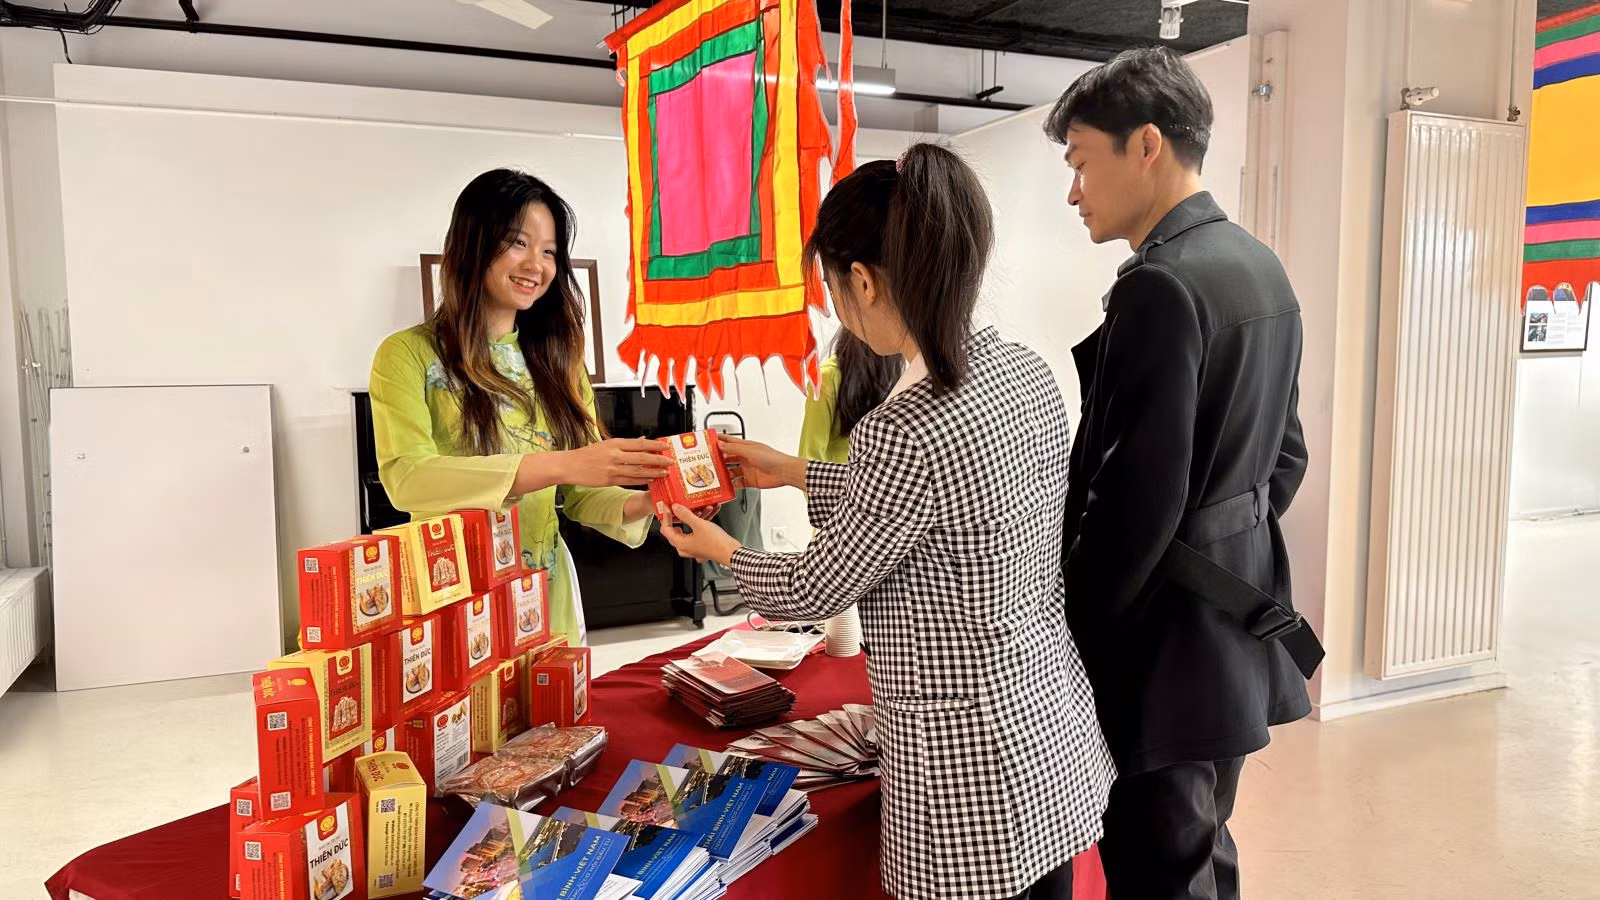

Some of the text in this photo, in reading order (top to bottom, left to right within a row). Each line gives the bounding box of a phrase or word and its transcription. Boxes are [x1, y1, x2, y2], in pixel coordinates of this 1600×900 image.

[404, 652, 420, 665] THIÊN
[767, 767, 779, 781] NAM
[702, 831, 715, 848] THÁI
[732, 782, 744, 799] NAM
[309, 848, 333, 869] THIÊN
[334, 838, 349, 854] ĐỨC
[586, 835, 601, 855] NAM
